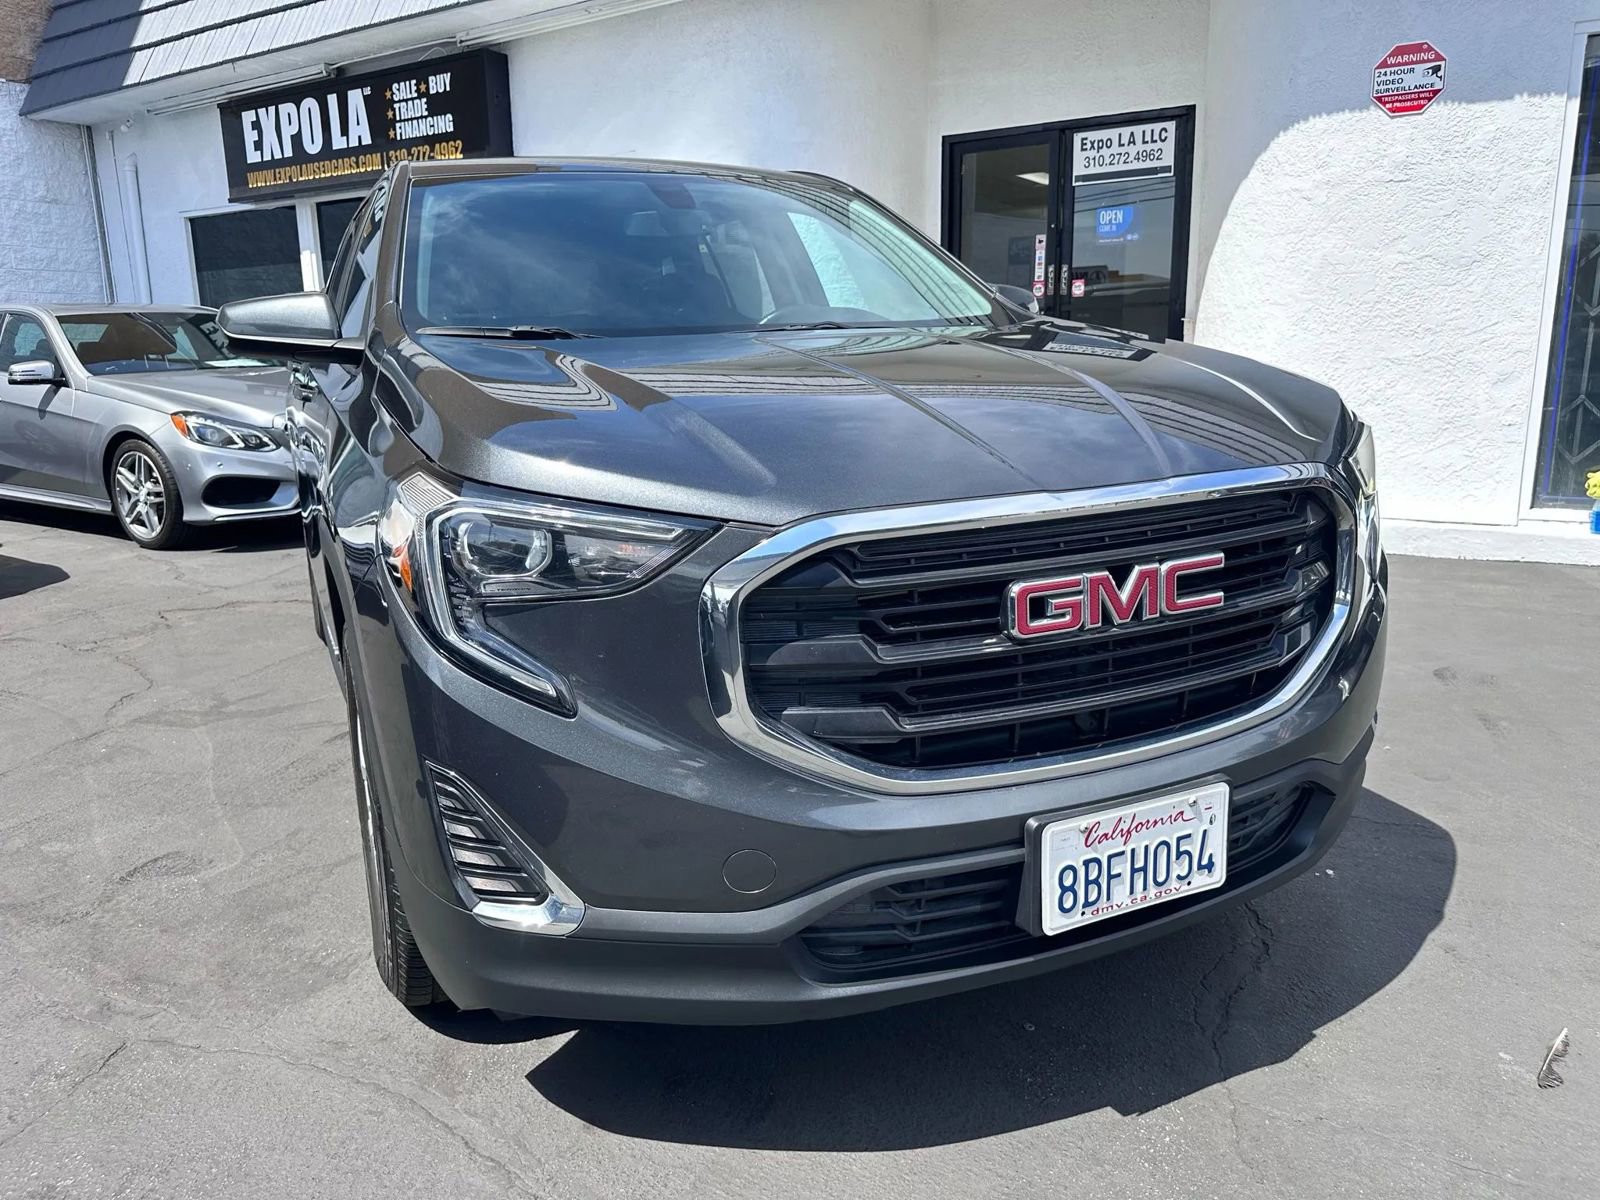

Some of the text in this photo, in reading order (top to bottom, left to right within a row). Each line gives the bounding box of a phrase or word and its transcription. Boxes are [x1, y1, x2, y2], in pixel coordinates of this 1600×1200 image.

[1386, 51, 1435, 65] WARNING
[1376, 67, 1415, 79] 24 HOUR
[1376, 77, 1404, 87] VIDEO
[392, 72, 451, 101] SALE BUY
[1375, 82, 1436, 95] SURVEILLANCE
[1381, 93, 1419, 103] TRESPASSERS
[393, 98, 428, 121] TRADE
[1393, 99, 1428, 108] PROSECUTED
[241, 97, 323, 164] EXPO
[328, 87, 372, 150] LA
[395, 113, 454, 141] FINANCING
[1080, 127, 1168, 153] Expo LA LLC
[1084, 148, 1163, 168] 310.272.4962
[247, 152, 382, 189] WWW.EXPOLAUSEDCARS.COM
[1099, 209, 1124, 225] OPEN
[1005, 552, 1225, 642] GMC
[1084, 811, 1197, 848] California
[1057, 829, 1215, 914] 8BFH054
[1091, 884, 1182, 917] dmv.ca.gov
